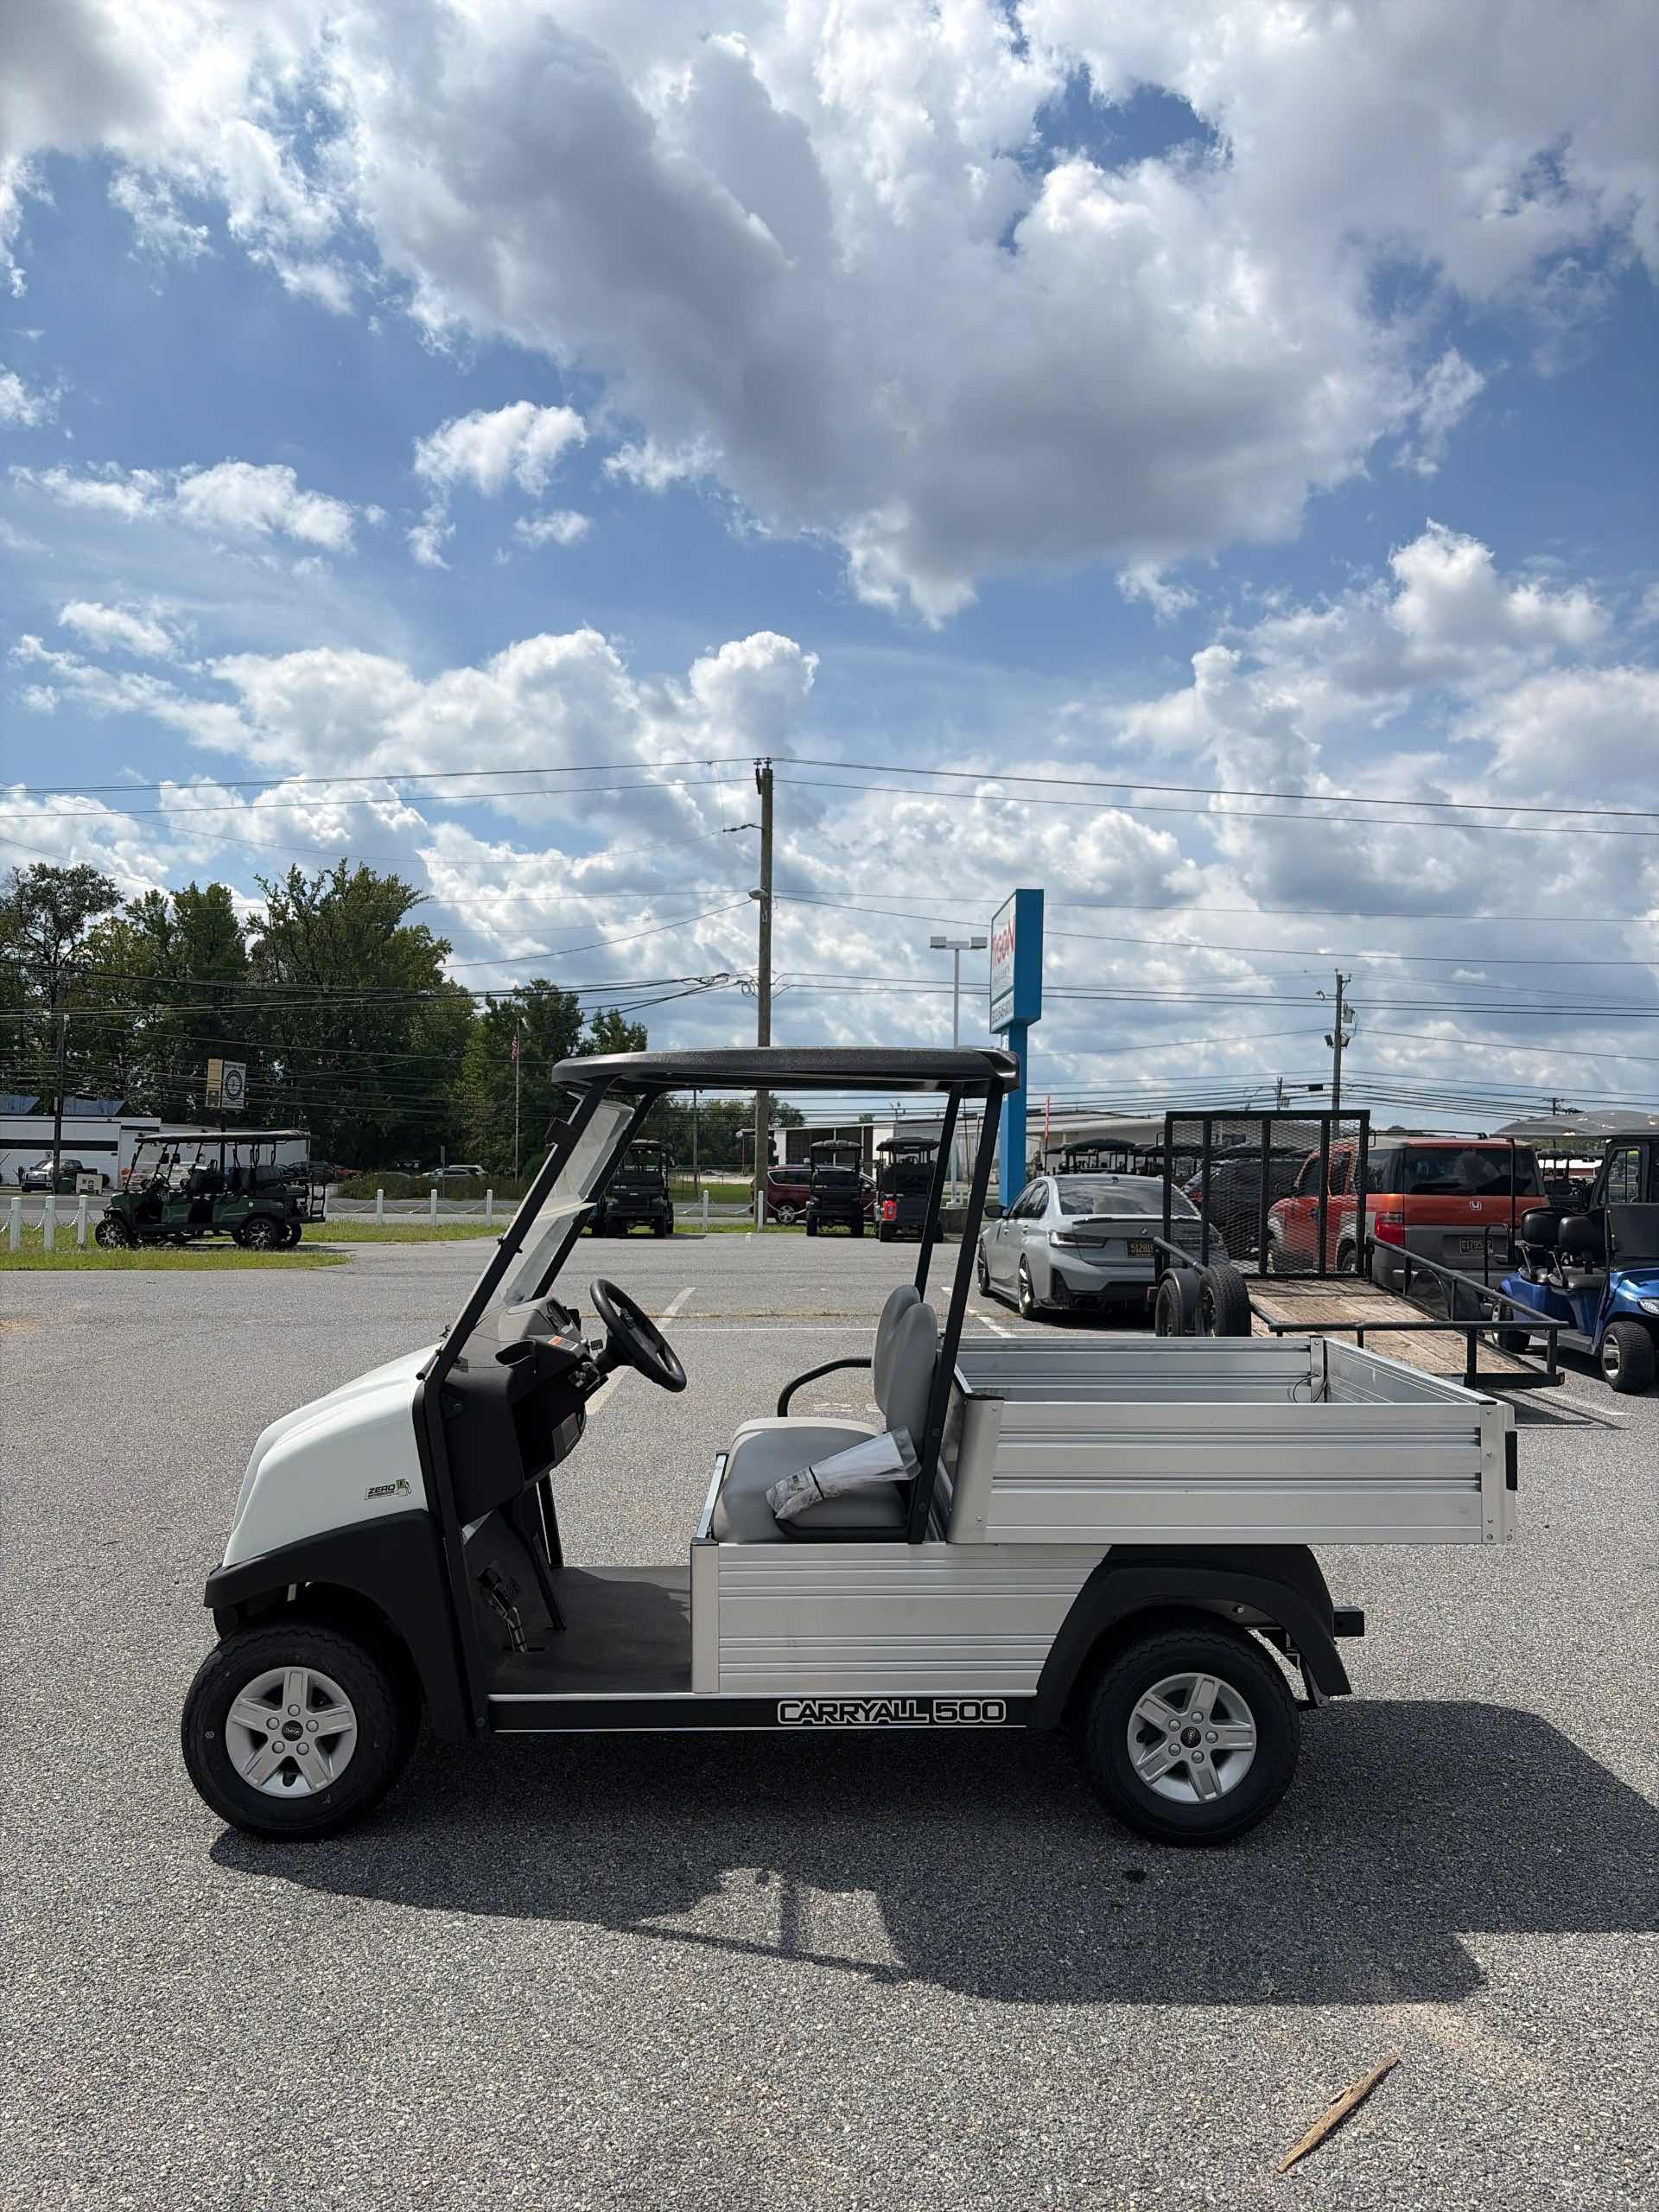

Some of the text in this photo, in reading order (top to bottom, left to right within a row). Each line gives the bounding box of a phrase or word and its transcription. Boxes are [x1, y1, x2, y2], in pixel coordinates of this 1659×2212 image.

[367, 1484, 396, 1495] ZERO
[778, 1699, 1007, 1725] CARRYALL 500
